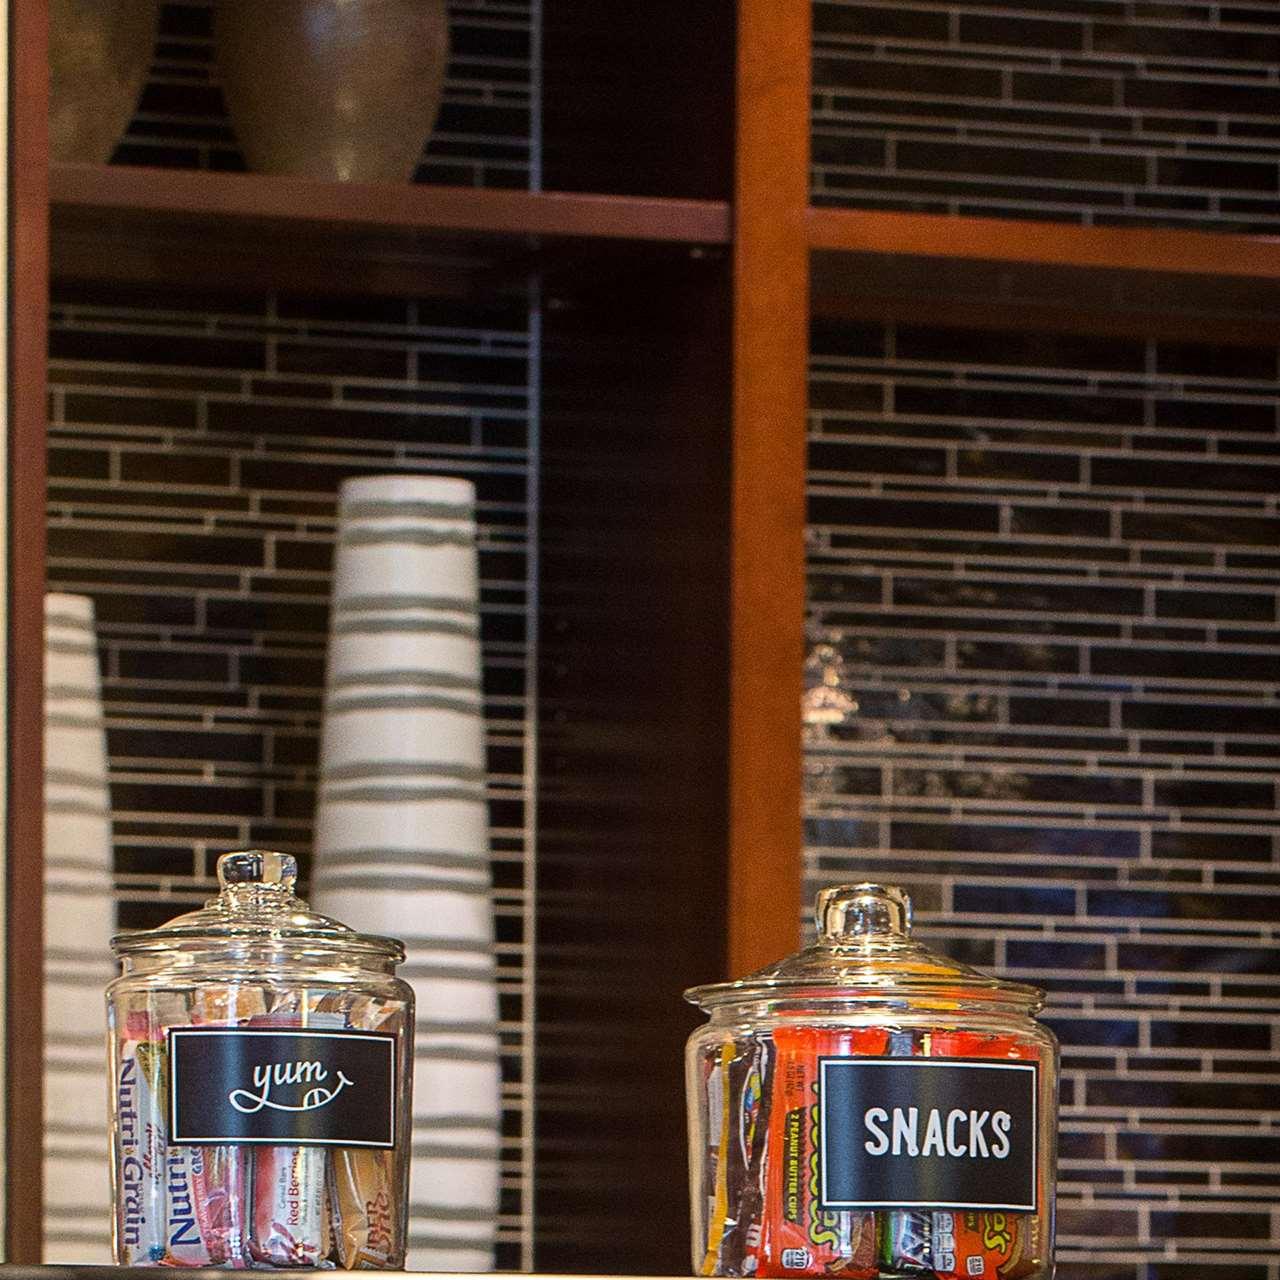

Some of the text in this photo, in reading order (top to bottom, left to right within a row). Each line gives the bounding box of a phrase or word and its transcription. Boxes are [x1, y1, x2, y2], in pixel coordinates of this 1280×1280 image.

[229, 1061, 328, 1113] yum
[119, 1057, 146, 1248] Nutri Grain
[788, 1121, 798, 1220] PEANUT BUTTER CUPS
[864, 1107, 1011, 1158] SNACKS
[168, 1156, 201, 1246] Nutri
[287, 1150, 300, 1226] Red Berries
